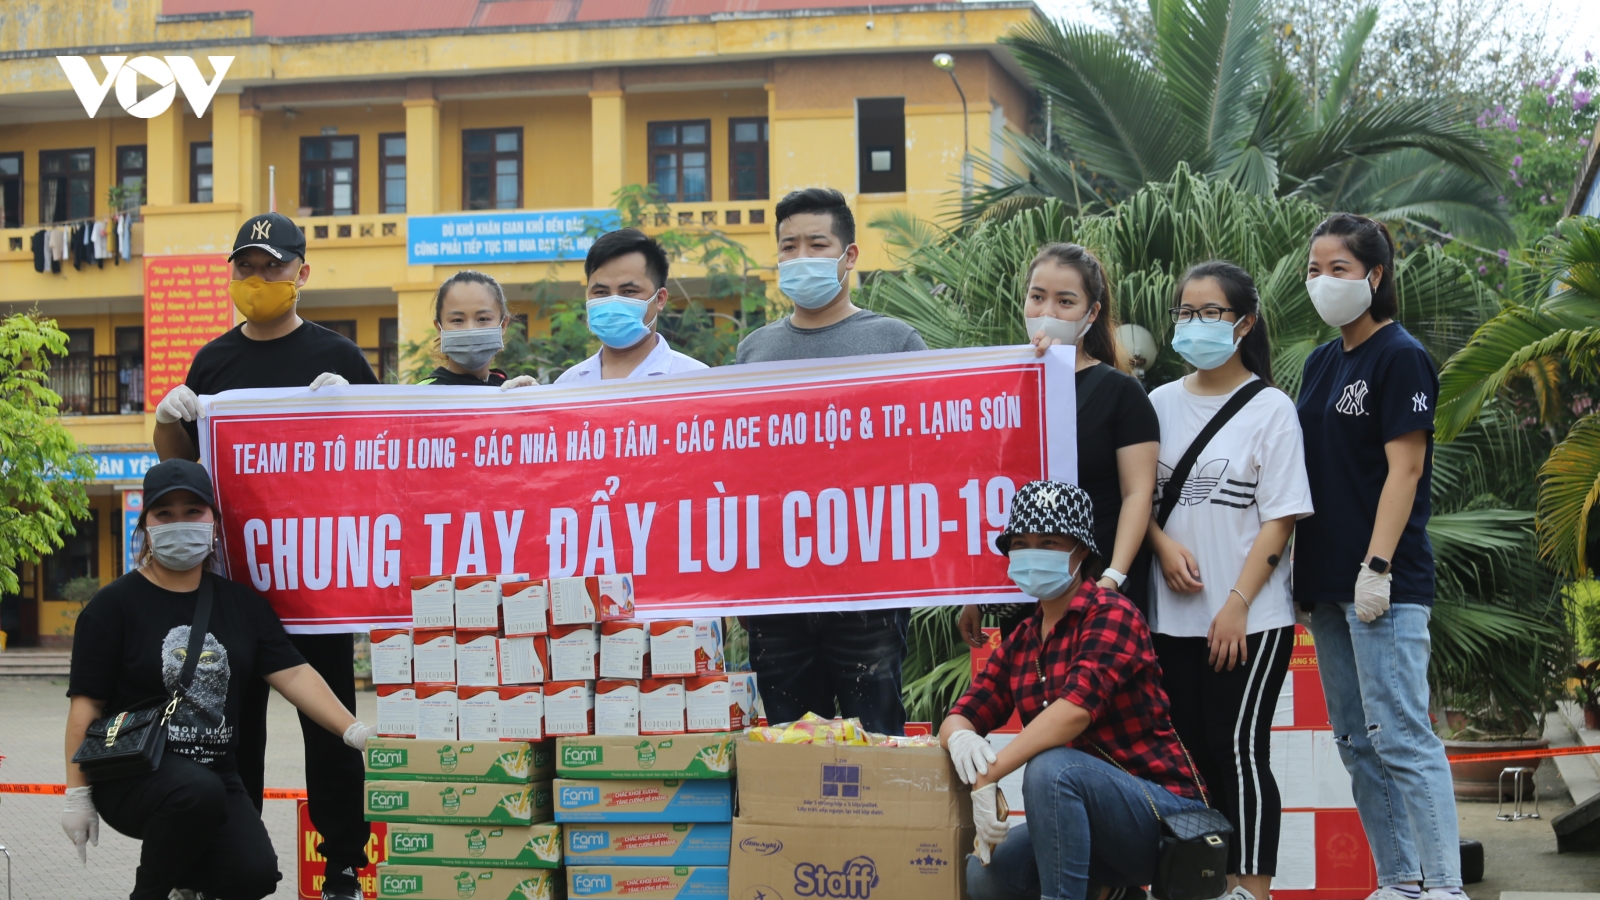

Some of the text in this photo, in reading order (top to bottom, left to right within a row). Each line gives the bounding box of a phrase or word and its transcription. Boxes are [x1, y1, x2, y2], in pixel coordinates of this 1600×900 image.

[233, 442, 287, 475] TEAM
[293, 441, 315, 472] FB
[322, 434, 346, 472] TÔ
[354, 430, 401, 470] HIẾU
[406, 437, 456, 469] LONG
[474, 429, 513, 468] CÁC
[520, 426, 558, 464] NHÀ
[566, 421, 606, 462] HẢO
[613, 420, 657, 458] TÂM
[676, 415, 715, 454] CÁC
[722, 416, 761, 450] ACE
[768, 411, 808, 447] CAO
[814, 403, 852, 450] LỘC
[859, 406, 874, 440] &
[881, 404, 912, 438] TP.
[920, 398, 973, 441] LẠNG
[980, 391, 1022, 431] SƠN
[243, 513, 402, 592] CHUNG
[424, 510, 526, 576] TAY
[546, 476, 657, 579] ĐẨY
[678, 481, 760, 574] LÙI
[782, 475, 1016, 569] COVID-19
[371, 750, 402, 764] Fami
[565, 747, 597, 761] Fami
[371, 792, 403, 806] Fami
[562, 788, 594, 801] Fami
[395, 834, 428, 848] Fami
[572, 832, 604, 845] Fami
[384, 876, 417, 890] Fami
[576, 876, 607, 888] Fami
[794, 861, 875, 900] Staff
